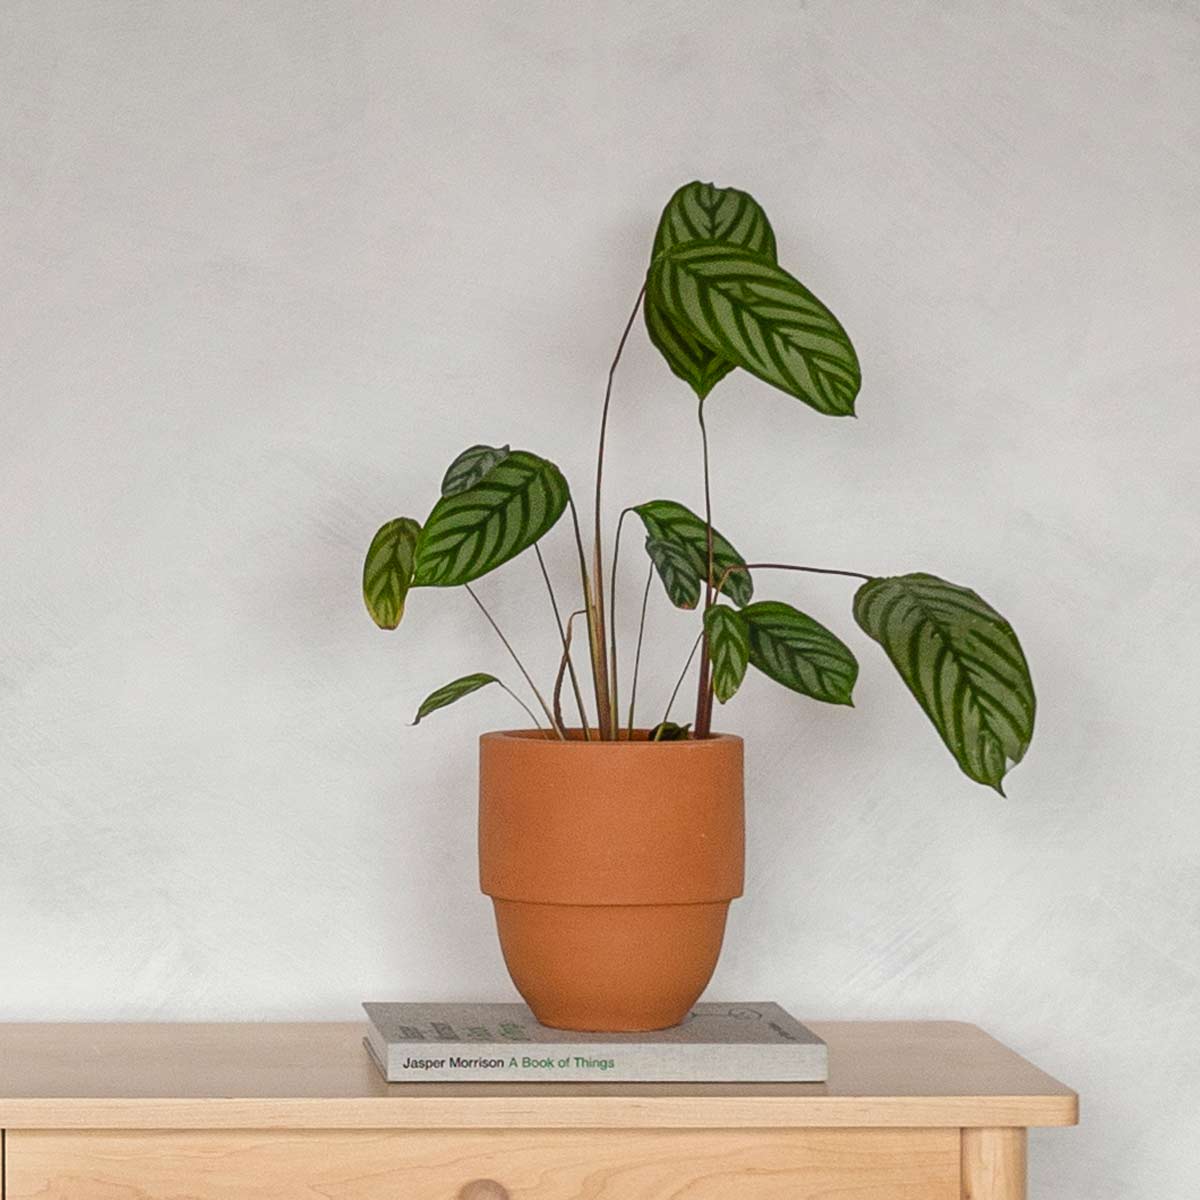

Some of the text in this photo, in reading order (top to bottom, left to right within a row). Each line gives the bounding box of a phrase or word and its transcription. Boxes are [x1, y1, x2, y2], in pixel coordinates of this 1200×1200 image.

[403, 1057, 615, 1070] Jasper Morrison A Book of Things
